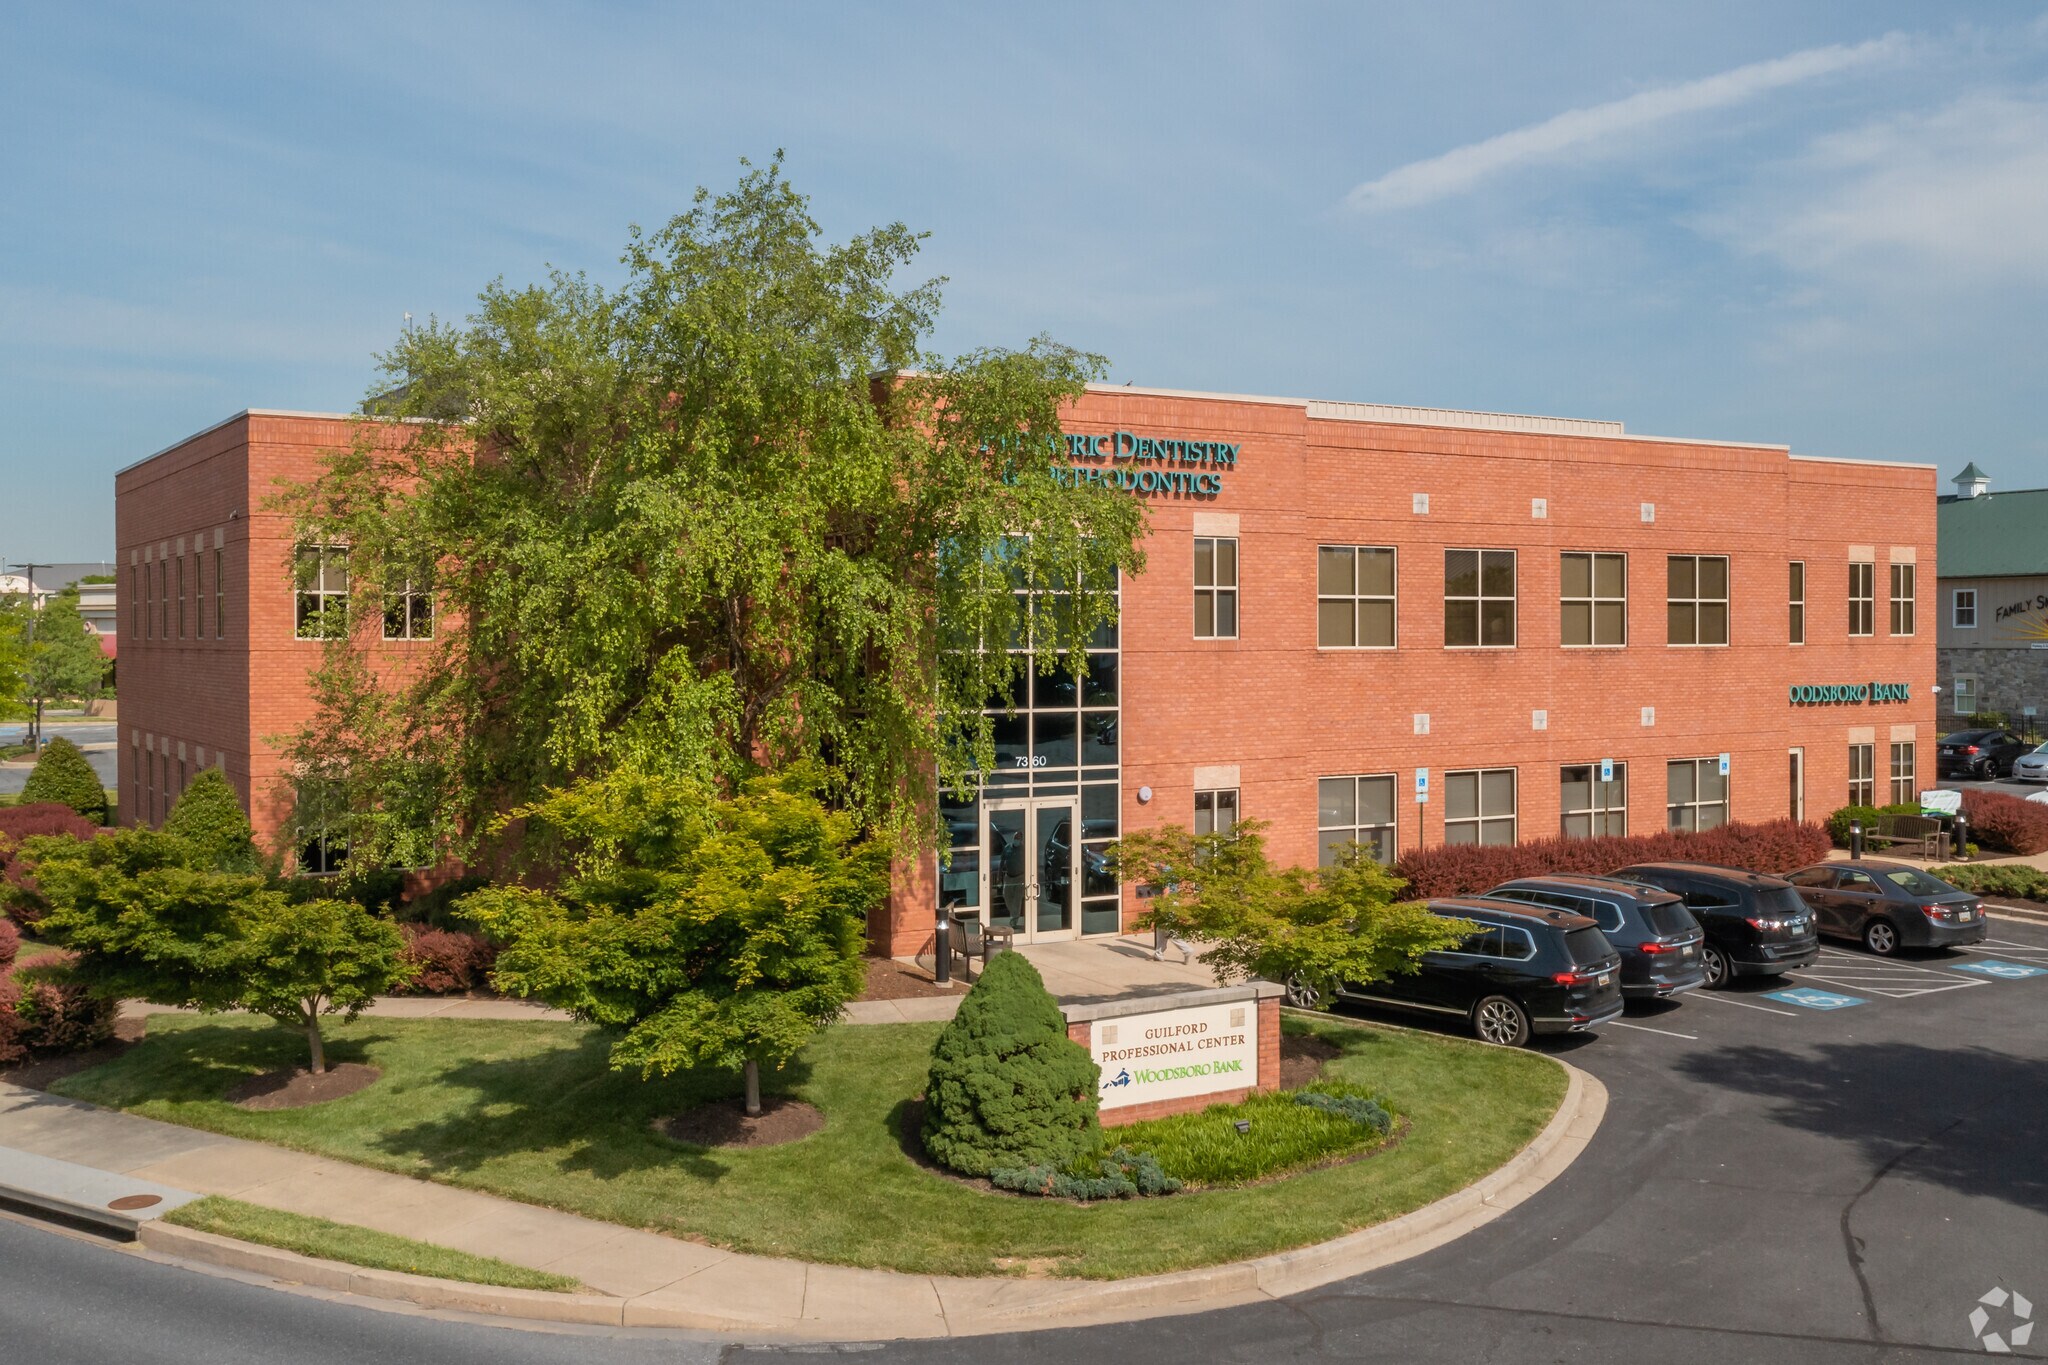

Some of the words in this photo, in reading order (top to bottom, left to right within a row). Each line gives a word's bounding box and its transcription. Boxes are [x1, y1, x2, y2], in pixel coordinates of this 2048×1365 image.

[1115, 431, 1241, 464] DENTISTRY
[1996, 600, 2032, 623] FAMILY
[1788, 684, 1869, 703] OODSBORO
[1872, 681, 1911, 702] BANK
[1016, 755, 1047, 767] 7360
[1145, 1022, 1208, 1039] GUILFORD
[1102, 1040, 1194, 1062] PROFESSIONAL
[1197, 1034, 1245, 1051] CENTER
[1134, 1063, 1211, 1085] WOODSBORO
[1213, 1059, 1243, 1075] BANK
